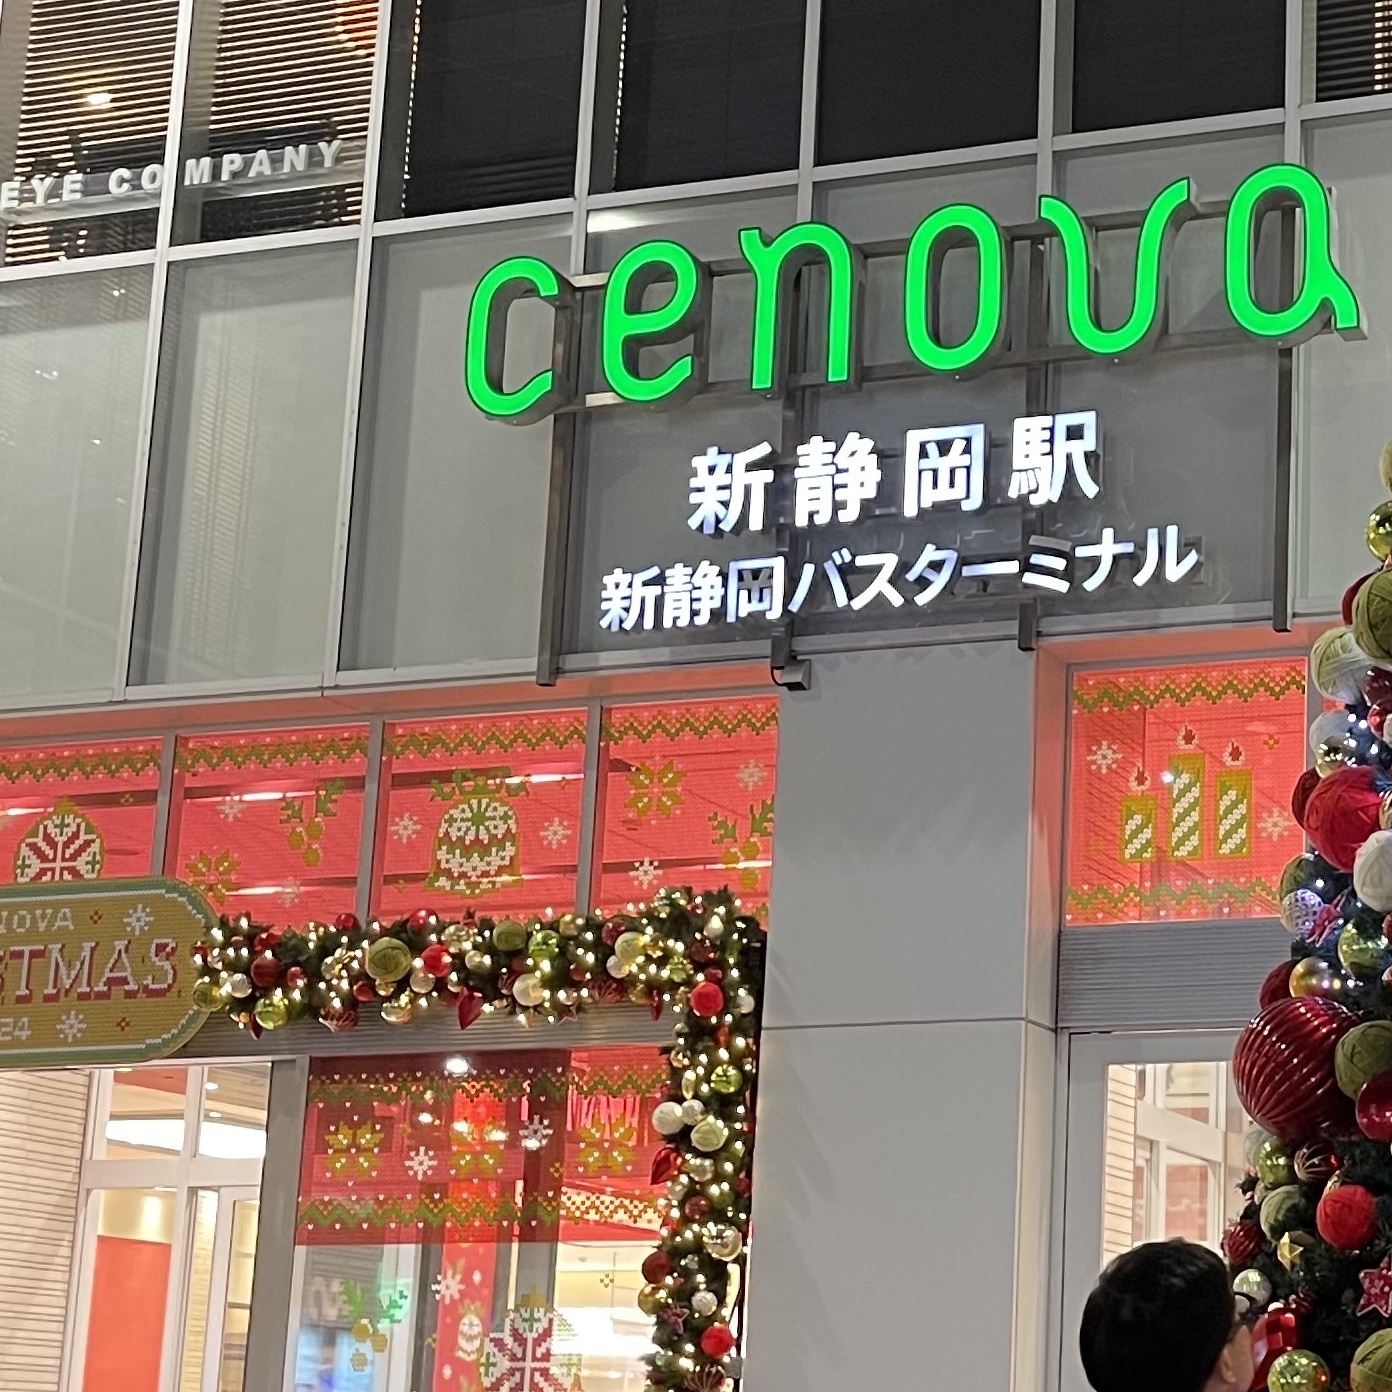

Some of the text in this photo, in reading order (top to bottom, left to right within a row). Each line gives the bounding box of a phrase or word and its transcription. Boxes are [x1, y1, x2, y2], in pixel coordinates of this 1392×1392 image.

[0, 139, 342, 208] EYE COMPANY
[465, 163, 1361, 417] cenova
[687, 409, 1101, 534] 新静岡駅
[599, 523, 1199, 633] 新静岡バスターミナル
[0, 938, 178, 1004] TMAS
